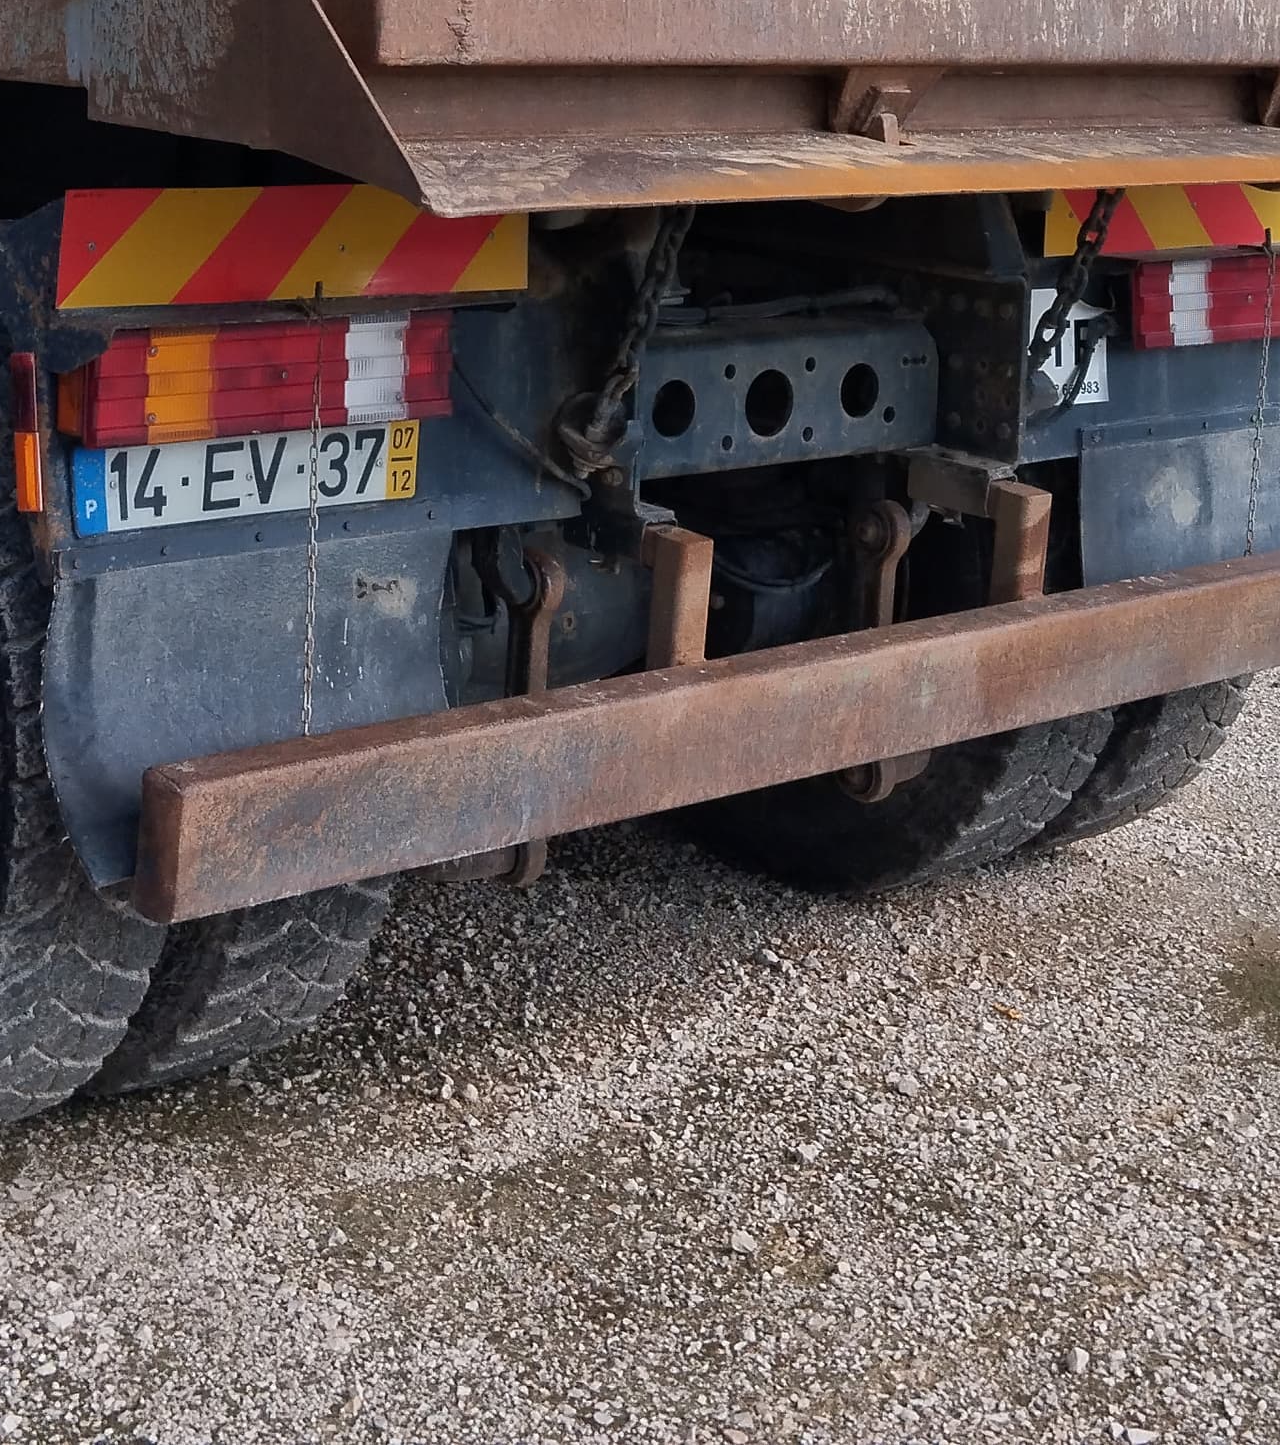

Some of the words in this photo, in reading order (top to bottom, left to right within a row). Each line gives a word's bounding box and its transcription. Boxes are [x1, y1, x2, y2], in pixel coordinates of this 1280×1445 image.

[392, 426, 416, 450] 07
[391, 468, 412, 494] 12
[85, 497, 99, 521] P
